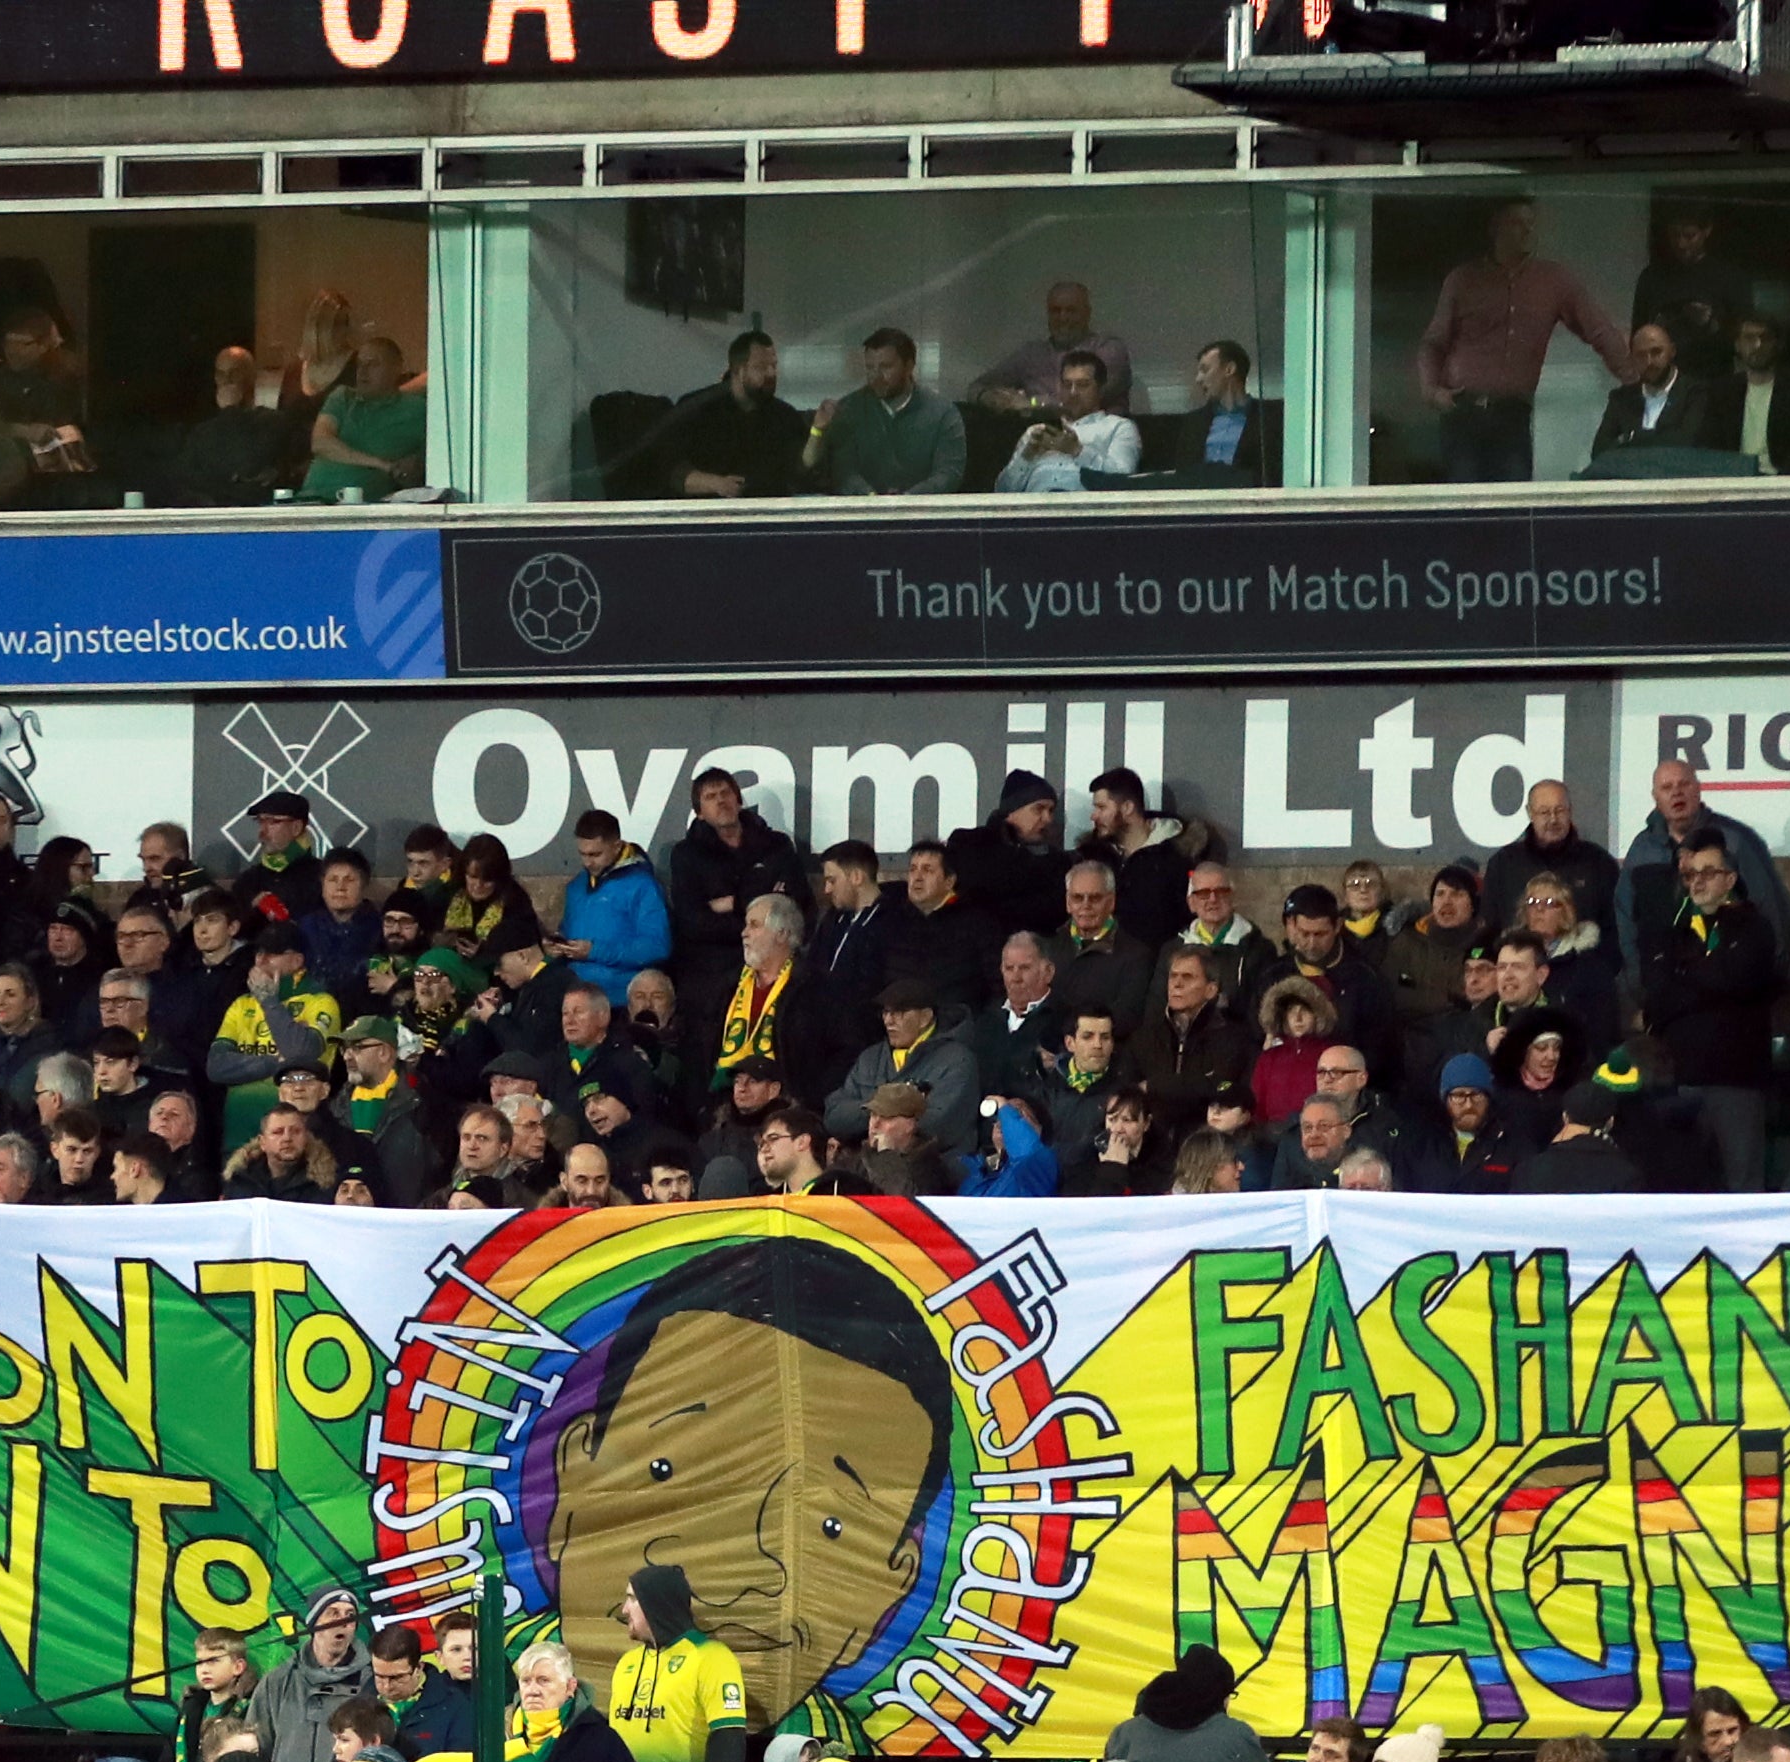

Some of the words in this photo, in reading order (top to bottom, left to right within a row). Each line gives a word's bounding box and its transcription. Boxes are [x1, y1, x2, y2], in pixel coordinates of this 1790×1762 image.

[867, 567, 1009, 618] Thank
[1023, 579, 1102, 629] you
[1115, 572, 1160, 615] to
[1177, 575, 1252, 614] our
[1268, 563, 1408, 612] Match
[1426, 557, 1663, 622] Sponsors!
[1242, 694, 1566, 850] Ltd
[614, 1702, 666, 1722] dafabet
